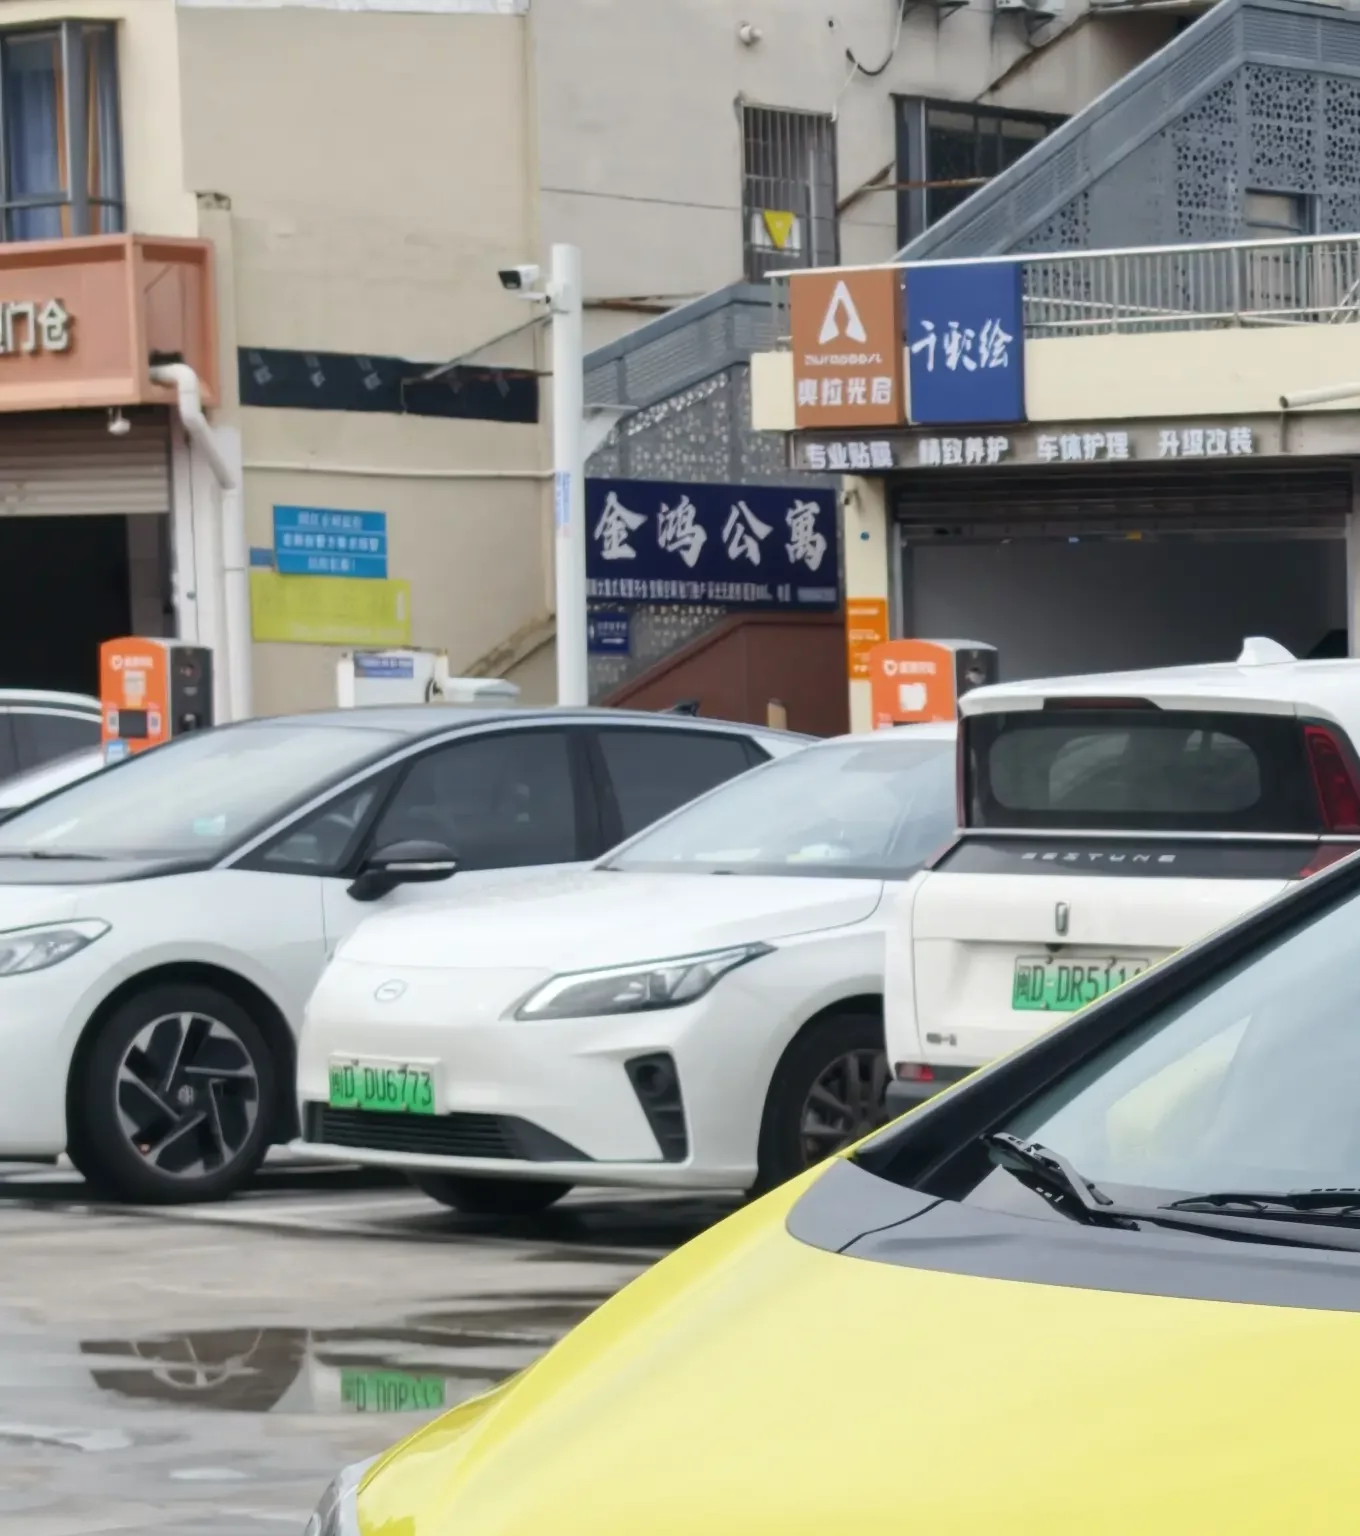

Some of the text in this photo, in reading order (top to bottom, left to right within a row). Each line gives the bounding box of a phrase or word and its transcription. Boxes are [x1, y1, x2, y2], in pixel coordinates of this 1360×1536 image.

[0, 299, 68, 352] 门仓
[806, 441, 893, 470] 专业贴膜
[918, 435, 1009, 466] 精致养护
[1159, 427, 1252, 457] 升级改装
[594, 490, 828, 572] 金鸿公寓
